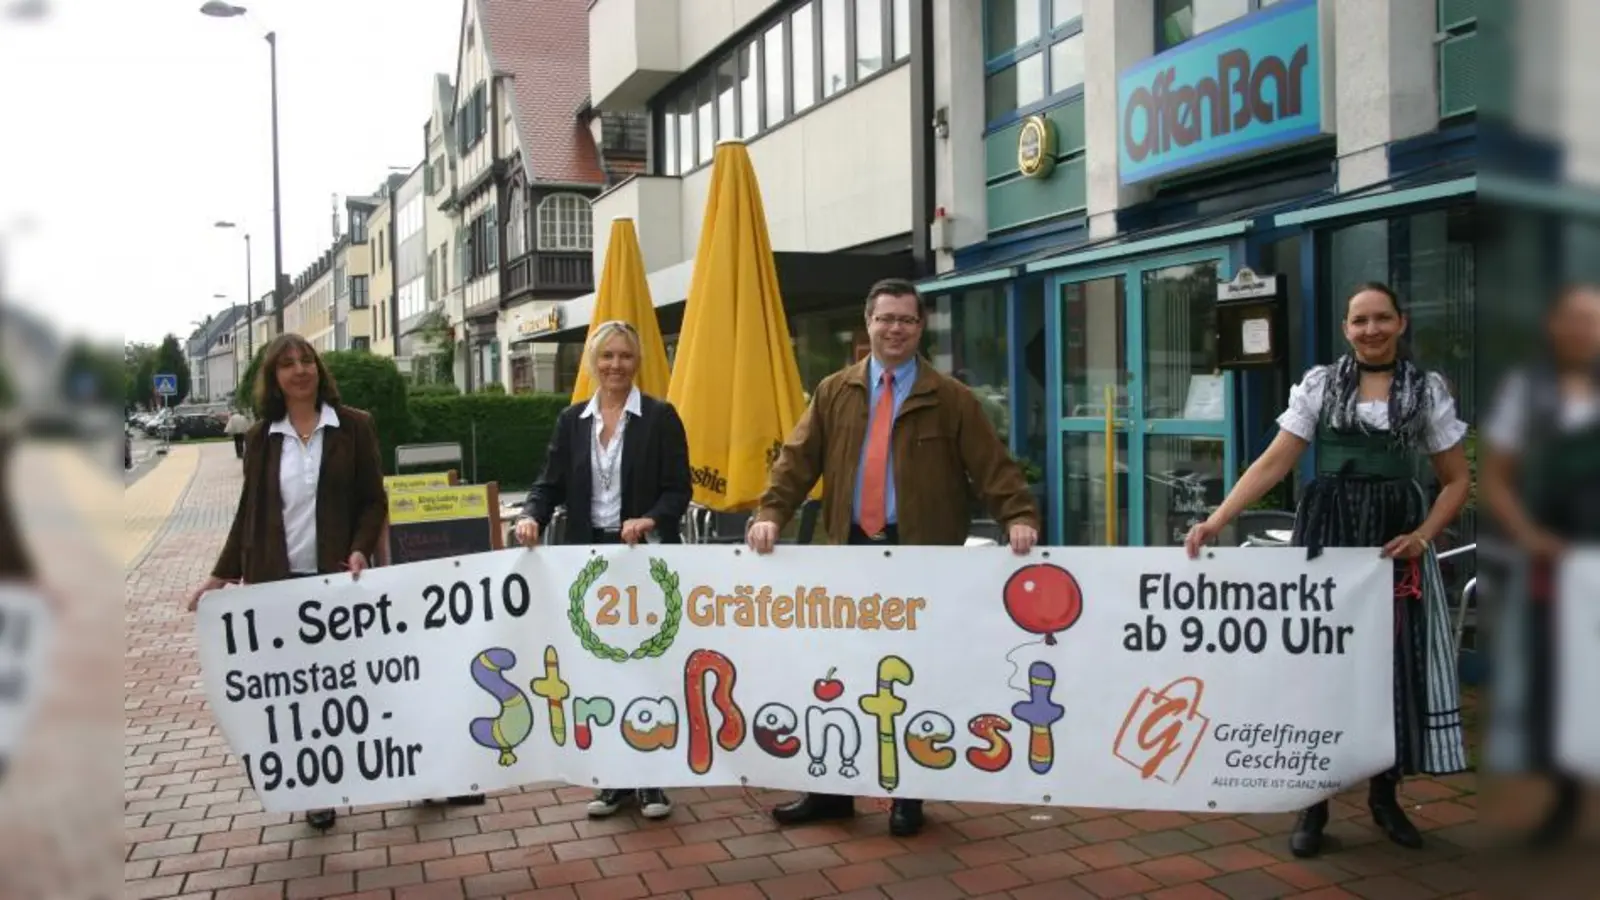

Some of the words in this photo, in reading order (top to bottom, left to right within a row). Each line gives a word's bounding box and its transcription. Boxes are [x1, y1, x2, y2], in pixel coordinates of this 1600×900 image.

[1124, 43, 1308, 162] OffenBar
[221, 609, 284, 654] 11.
[298, 593, 407, 645] Sept.
[422, 573, 530, 630] 2010
[596, 585, 659, 626] 21.
[687, 585, 926, 631] Gräfelfinger
[1139, 573, 1336, 612] Flohmarkt
[1123, 615, 1167, 651] ab
[1180, 616, 1267, 654] 9.00
[1282, 617, 1354, 655] Uhr
[225, 660, 357, 702] Samstag
[367, 655, 420, 686] von
[265, 695, 369, 744] 11.00
[469, 645, 1065, 792] Straßenfest
[1214, 723, 1344, 750] Gräfelfinger
[242, 744, 344, 791] 19.00
[357, 737, 423, 781] Uhr
[1225, 750, 1331, 776] Geschäfte
[1242, 778, 1269, 788] GUTE
[1270, 778, 1284, 788] IST
[1286, 779, 1315, 789] GANZ
